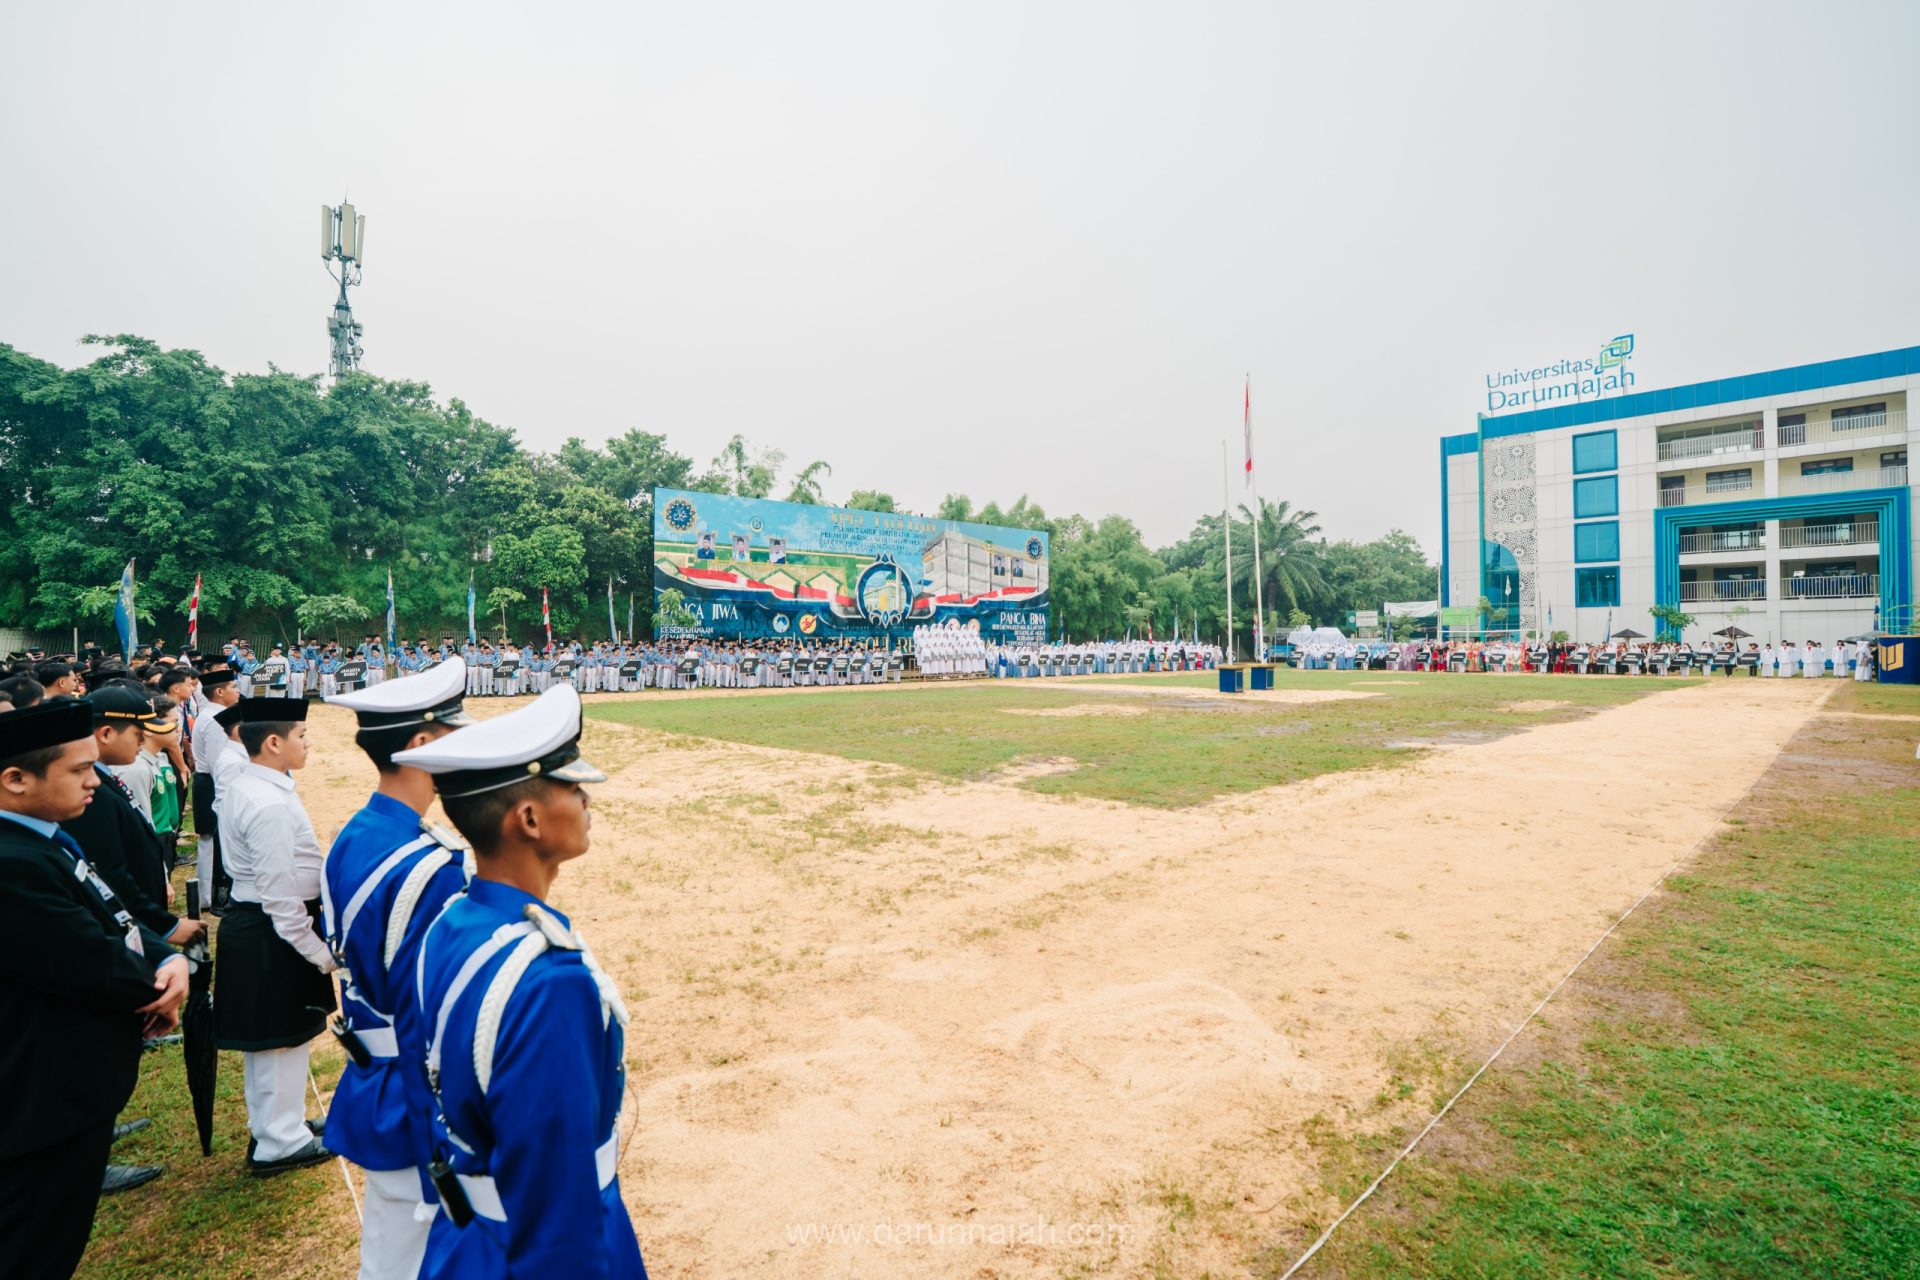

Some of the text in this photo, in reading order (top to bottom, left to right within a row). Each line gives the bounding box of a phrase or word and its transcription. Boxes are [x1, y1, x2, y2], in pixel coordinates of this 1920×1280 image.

[1486, 358, 1594, 389] Universitas
[1487, 365, 1635, 411] Darunnajah
[712, 603, 739, 620] JIWA
[1000, 611, 1026, 625] PANCA
